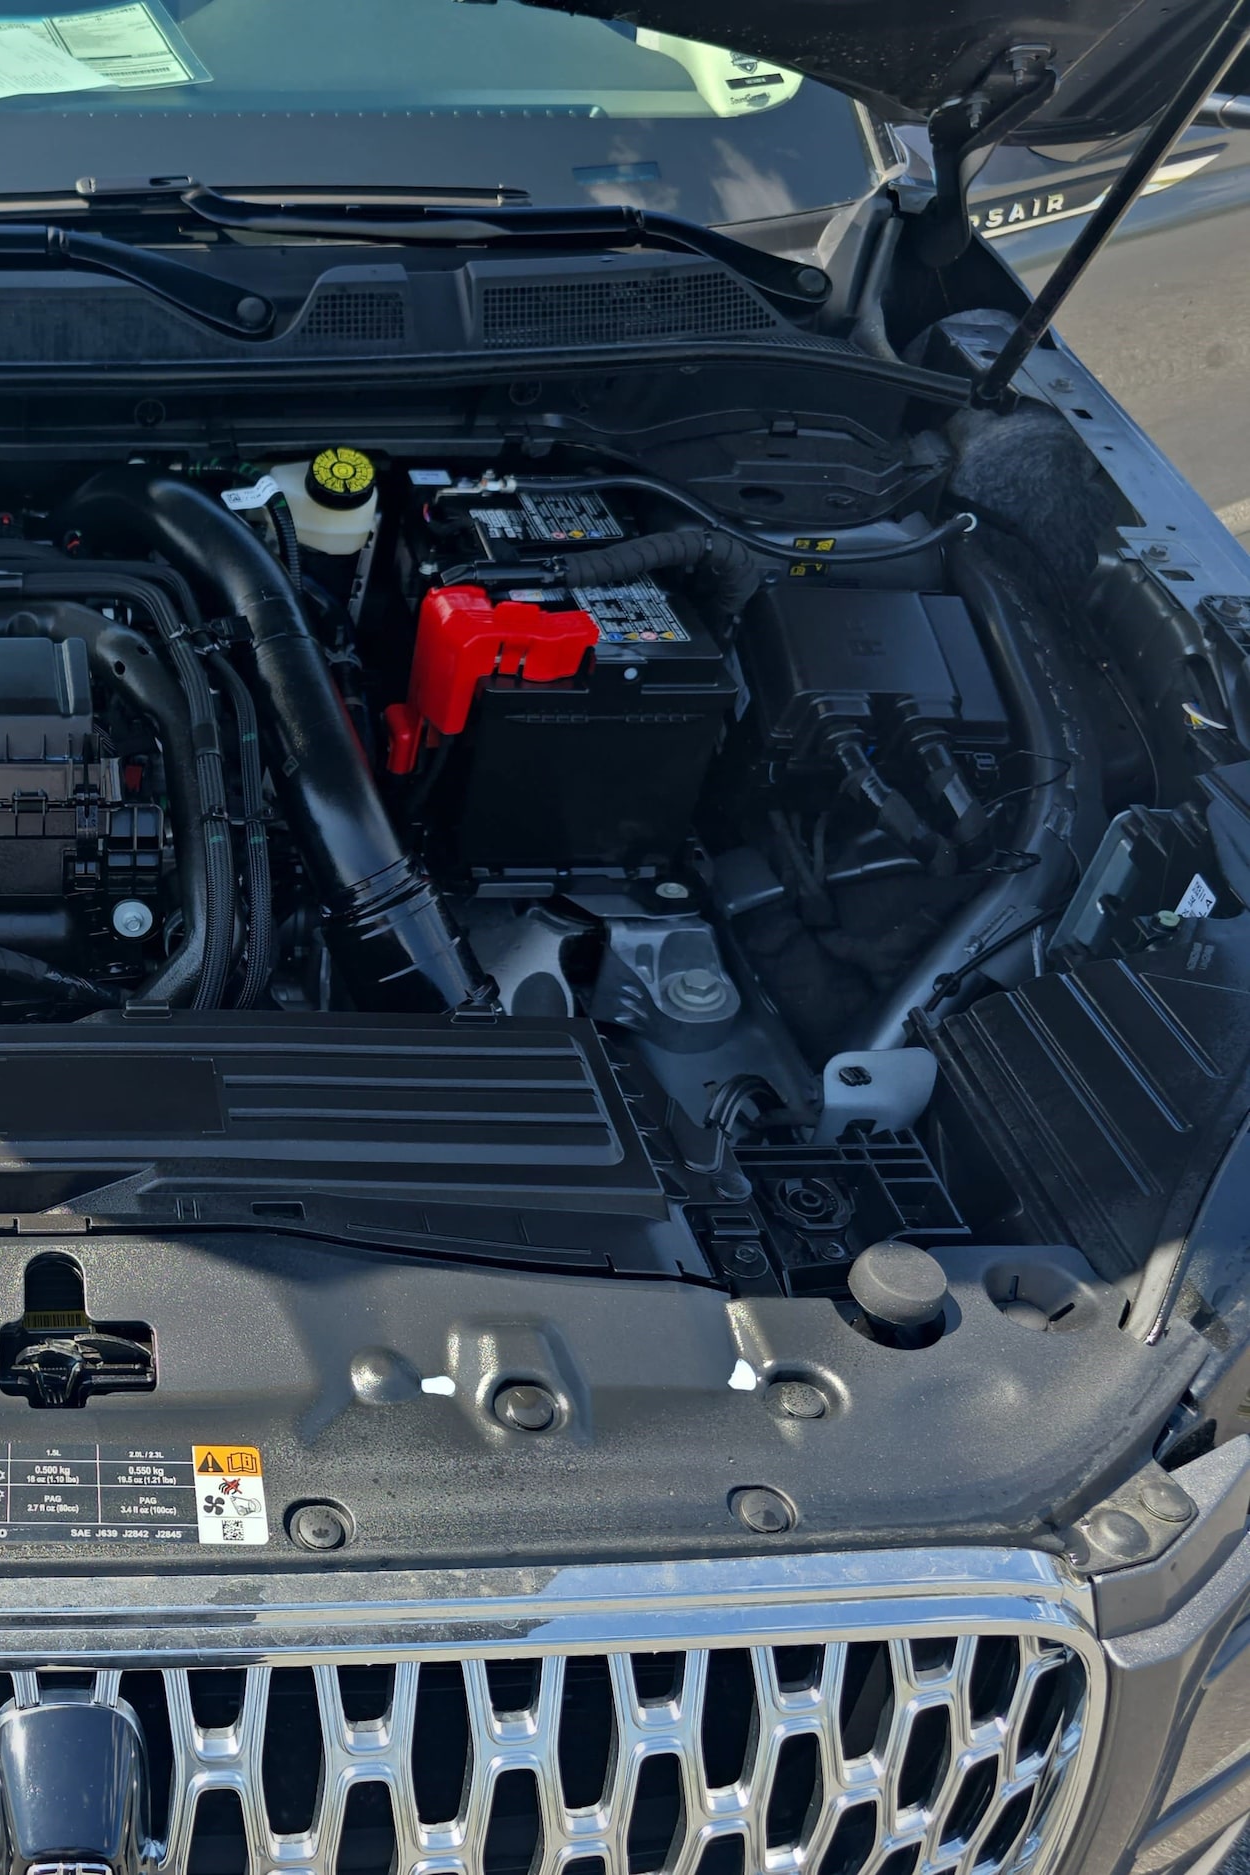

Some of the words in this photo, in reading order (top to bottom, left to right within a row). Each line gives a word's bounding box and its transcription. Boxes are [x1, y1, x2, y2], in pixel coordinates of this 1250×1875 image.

[34, 1465, 57, 1474] 0.500
[59, 1465, 71, 1476] kg
[128, 1466, 151, 1475] 0.550
[153, 1466, 164, 1477] kg
[117, 1476, 133, 1484] 19.5
[44, 1495, 62, 1503] PAG
[139, 1497, 157, 1505] PAG
[27, 1504, 38, 1512] 2.7
[120, 1506, 132, 1514] 3.4
[70, 1529, 91, 1537] SAE
[95, 1529, 118, 1538] J639
[122, 1529, 149, 1538] J2842
[154, 1530, 182, 1539] J2845
